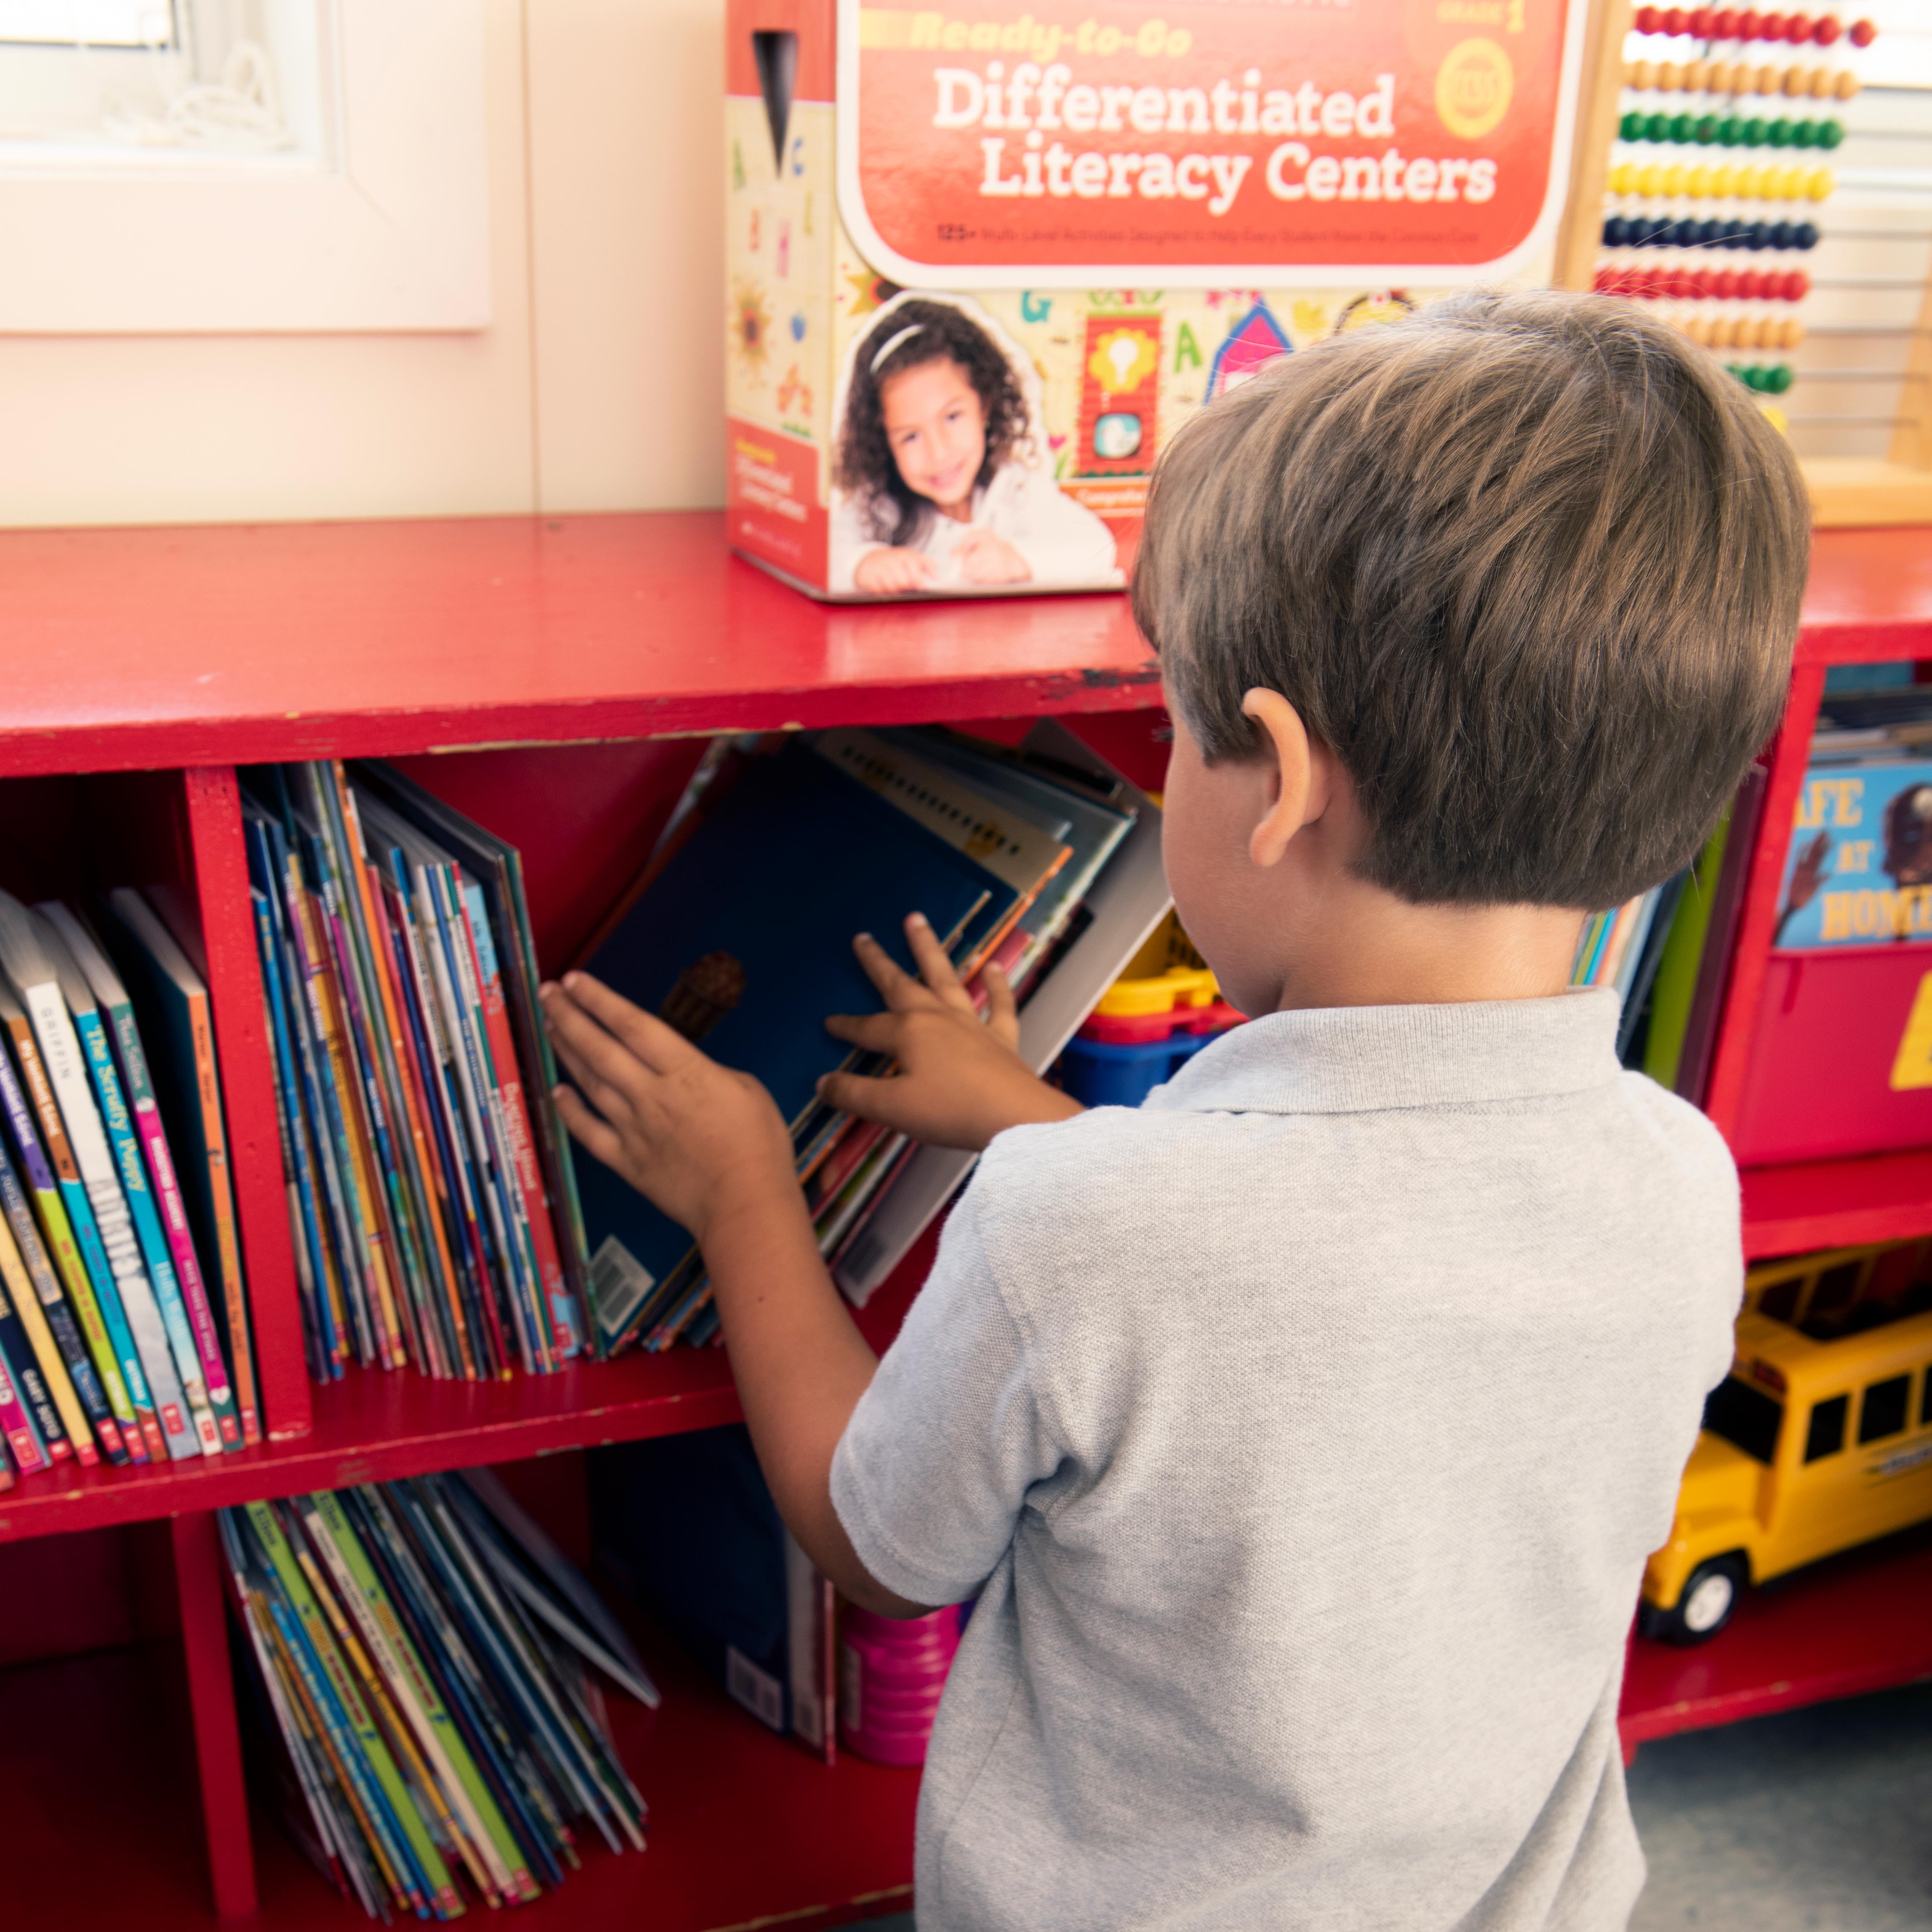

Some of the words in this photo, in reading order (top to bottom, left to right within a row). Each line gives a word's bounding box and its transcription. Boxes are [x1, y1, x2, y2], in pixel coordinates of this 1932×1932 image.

[909, 11, 1193, 64] Ready-to-Go
[932, 59, 1395, 138] Differentiated
[979, 131, 1253, 216] Literacy
[1266, 141, 1498, 204] Centers
[1838, 841, 1874, 871] AT
[41, 1007, 71, 1079] GRIFFIN
[86, 1025, 109, 1062] The
[97, 1063, 130, 1133] Scruffy
[118, 1138, 146, 1193] Puppy
[22, 1369, 45, 1405] GARY
[37, 1403, 62, 1439] SOTO
